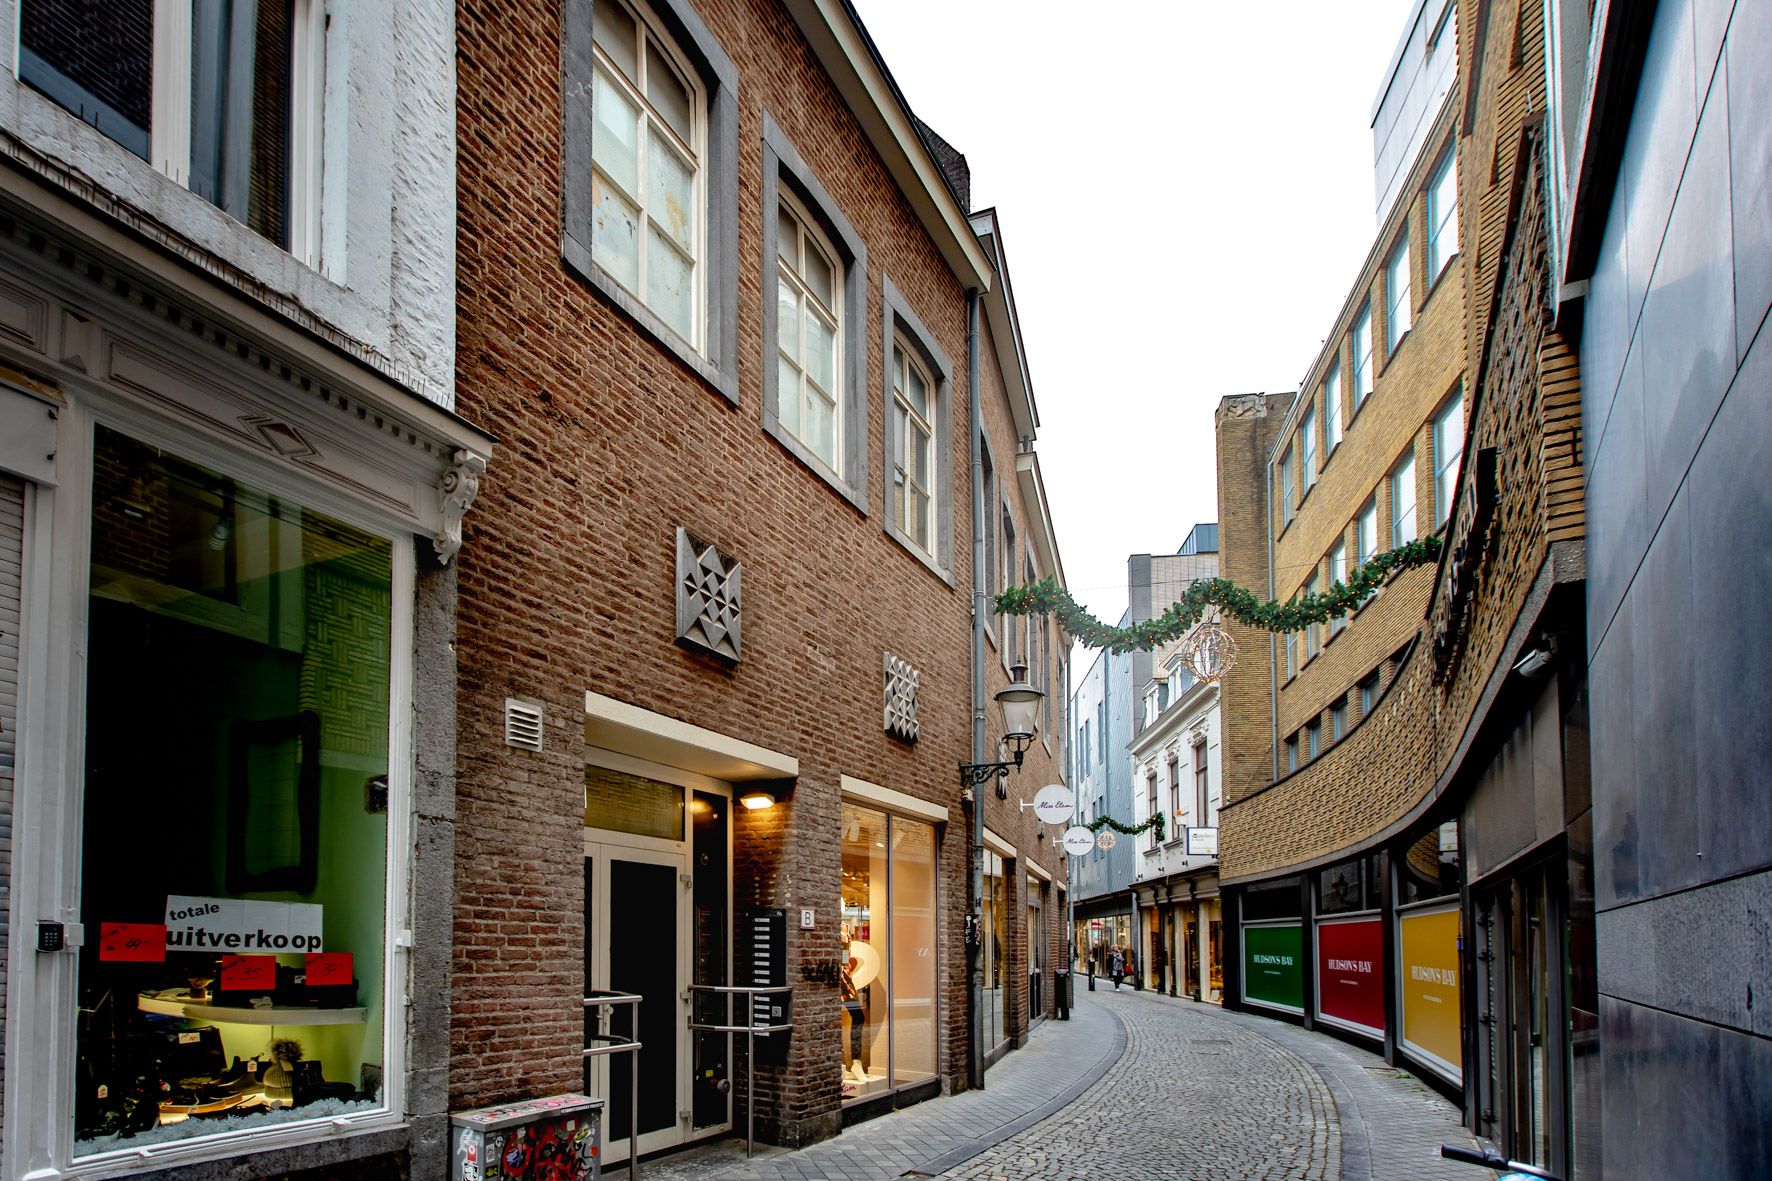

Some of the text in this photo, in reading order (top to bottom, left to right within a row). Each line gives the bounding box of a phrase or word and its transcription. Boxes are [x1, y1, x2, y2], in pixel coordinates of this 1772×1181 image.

[1037, 801, 1073, 809] Miss Etam
[169, 903, 220, 921] totale
[804, 911, 811, 926] B
[166, 926, 322, 952] uitverkoop
[1253, 954, 1294, 966] HUDSON'S BAY
[1328, 958, 1373, 973] HUDSON'S BAY
[1441, 968, 1457, 987] BAY
